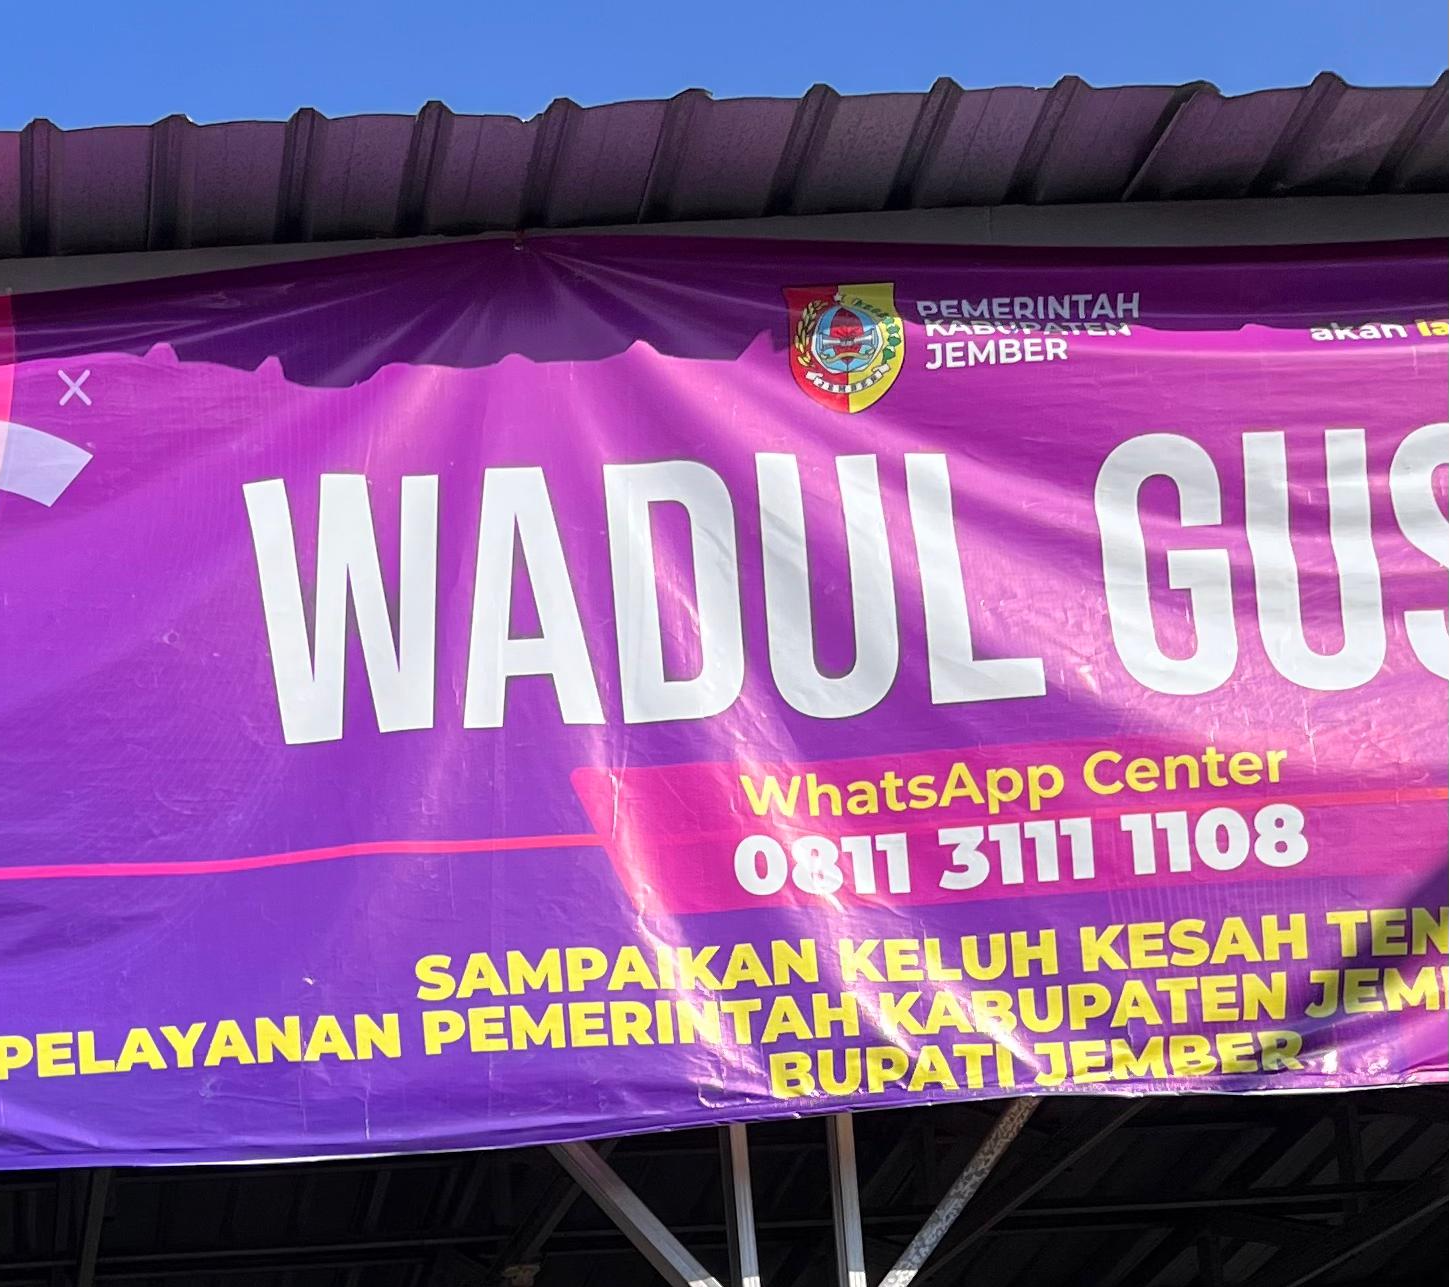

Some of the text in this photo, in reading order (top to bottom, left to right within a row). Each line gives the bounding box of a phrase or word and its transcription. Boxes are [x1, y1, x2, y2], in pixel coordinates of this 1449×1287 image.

[917, 292, 1141, 319] PEMERINTAH
[1310, 322, 1408, 340] akan
[925, 338, 1069, 370] JEMBER
[242, 452, 1046, 746] WADUL
[740, 745, 1288, 821] WhatsApp Center
[733, 803, 1309, 897] 0811 3111 1108
[416, 906, 1449, 1001] SAMPAIKAN KELUH KESAH TEN
[422, 993, 861, 1055] PEMERINTAH
[880, 970, 1287, 1038] KABUPATEN
[1304, 966, 1449, 1018] JEM
[768, 1028, 1305, 1100] BUPATI JEMBER
